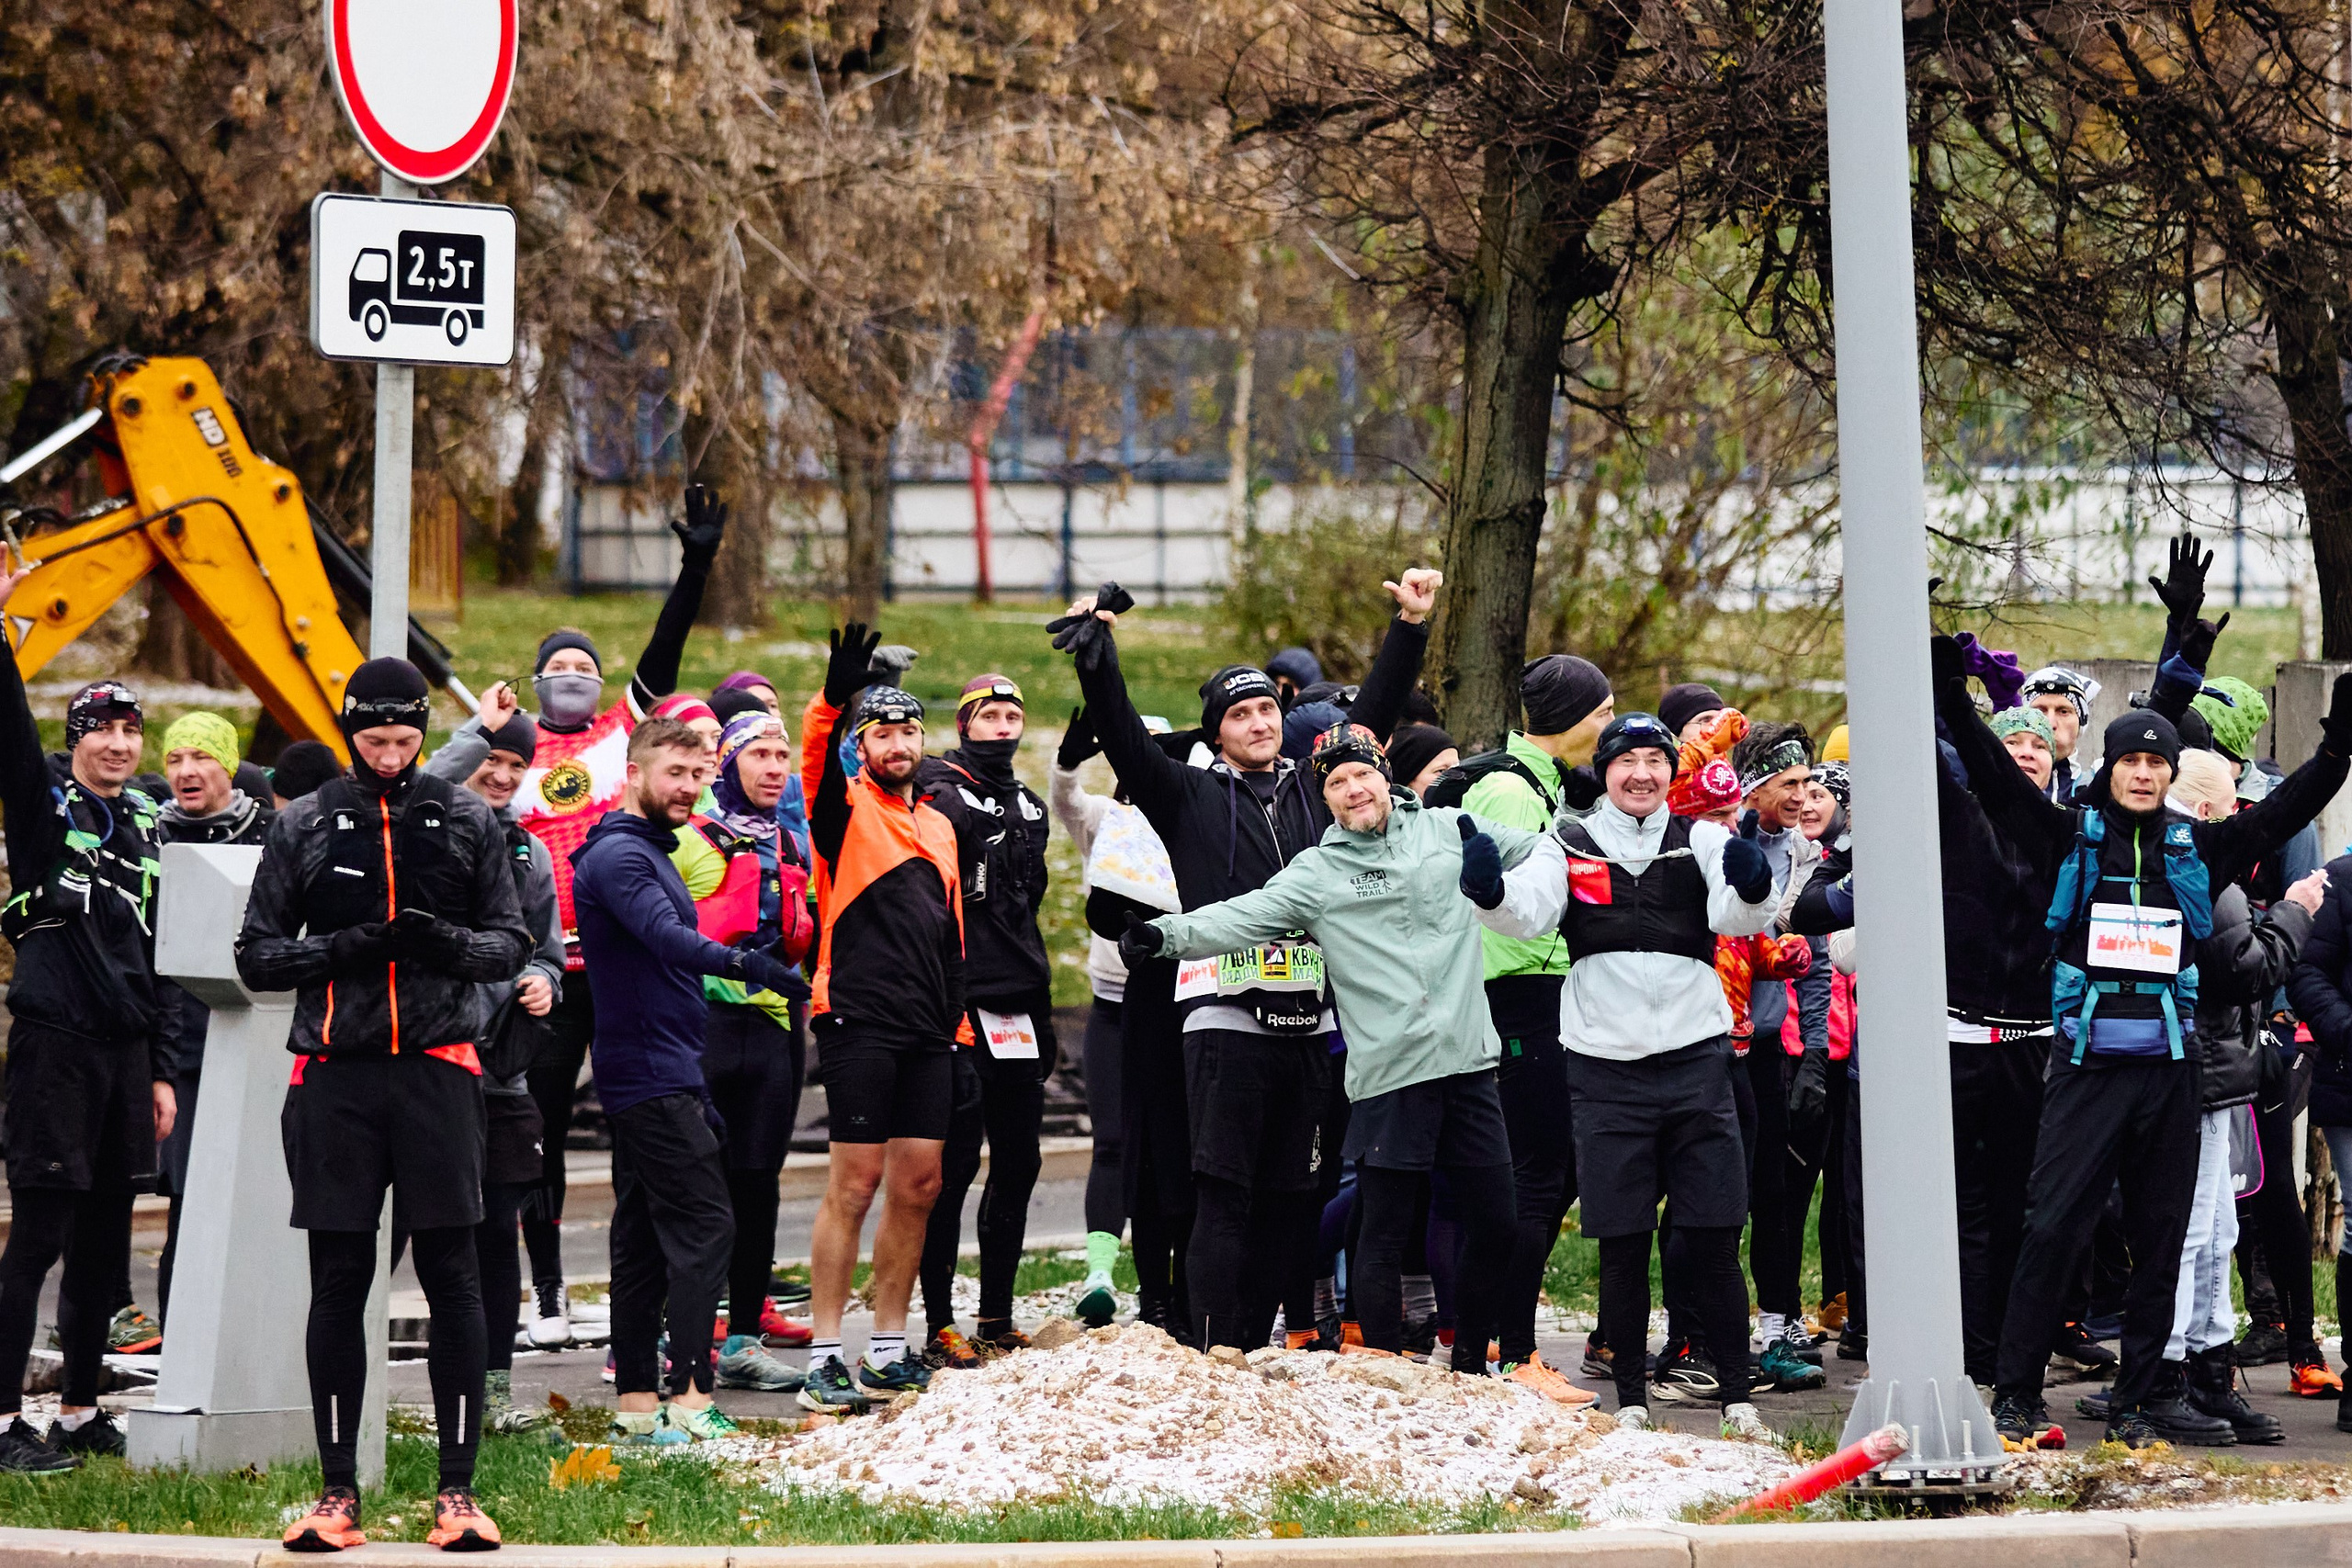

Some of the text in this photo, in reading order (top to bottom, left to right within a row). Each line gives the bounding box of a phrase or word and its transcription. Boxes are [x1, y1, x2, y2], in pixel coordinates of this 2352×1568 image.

[1224, 672, 1265, 690] JCB
[1229, 682, 1267, 696] ATTACHMENTS
[1351, 870, 1385, 885] TEAM
[1355, 883, 1380, 891] WILD
[1356, 889, 1384, 898] TRAIL
[1267, 1013, 1318, 1027] Reebok
